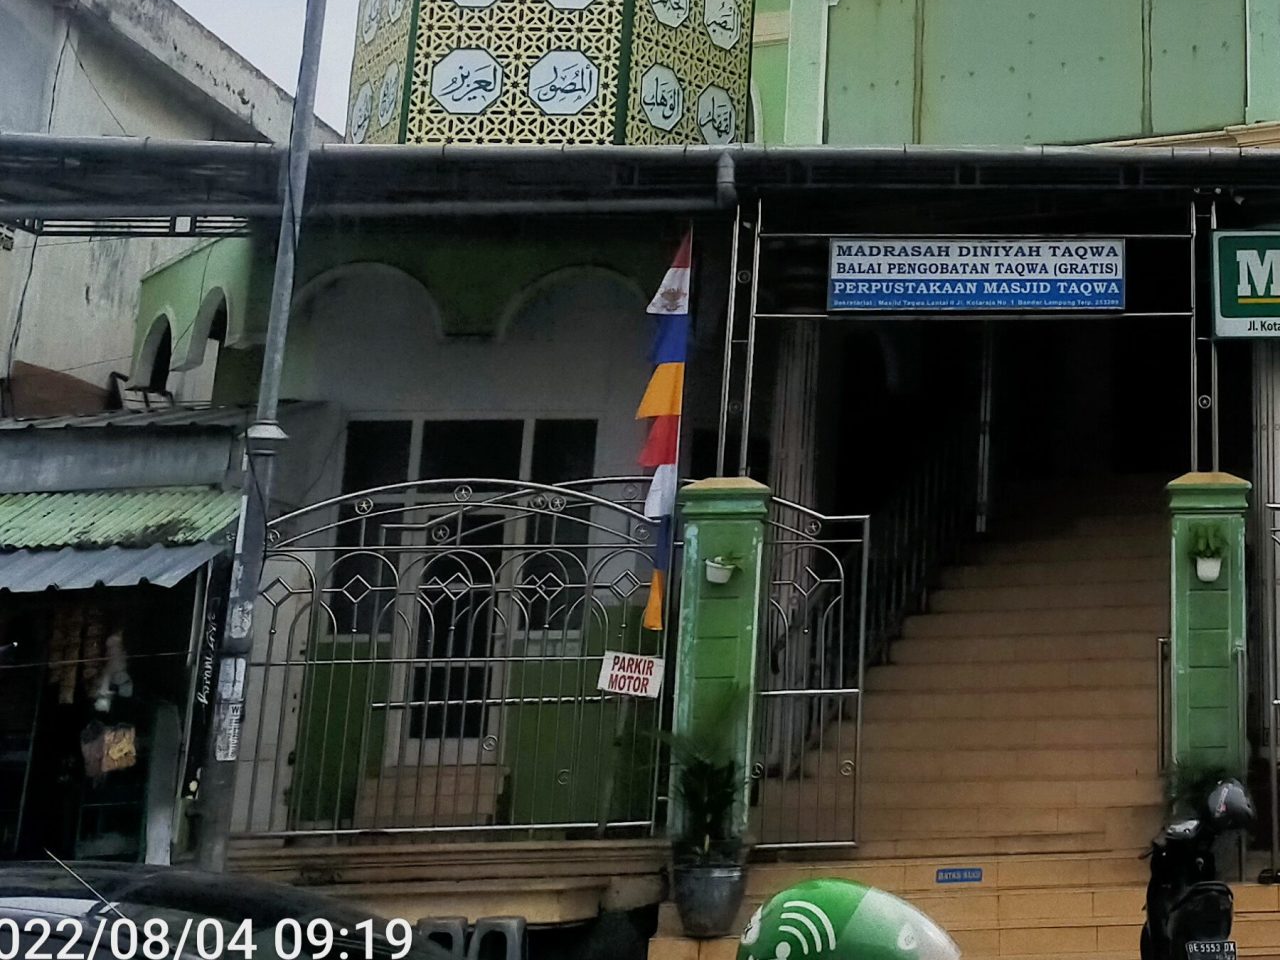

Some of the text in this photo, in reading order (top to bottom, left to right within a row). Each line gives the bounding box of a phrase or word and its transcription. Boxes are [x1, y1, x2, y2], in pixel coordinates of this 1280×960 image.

[836, 245, 1119, 260] MADRASAH DINIYAH TAQWA
[836, 262, 1118, 277] BALAI PENGOBATAN TAQWA (GRATIS)
[833, 282, 1120, 297] PERPUSTAKAAN MASJID TAQWA
[1248, 320, 1258, 331] Jl.
[611, 655, 655, 676] PARKIR
[607, 673, 650, 694] MOTOR
